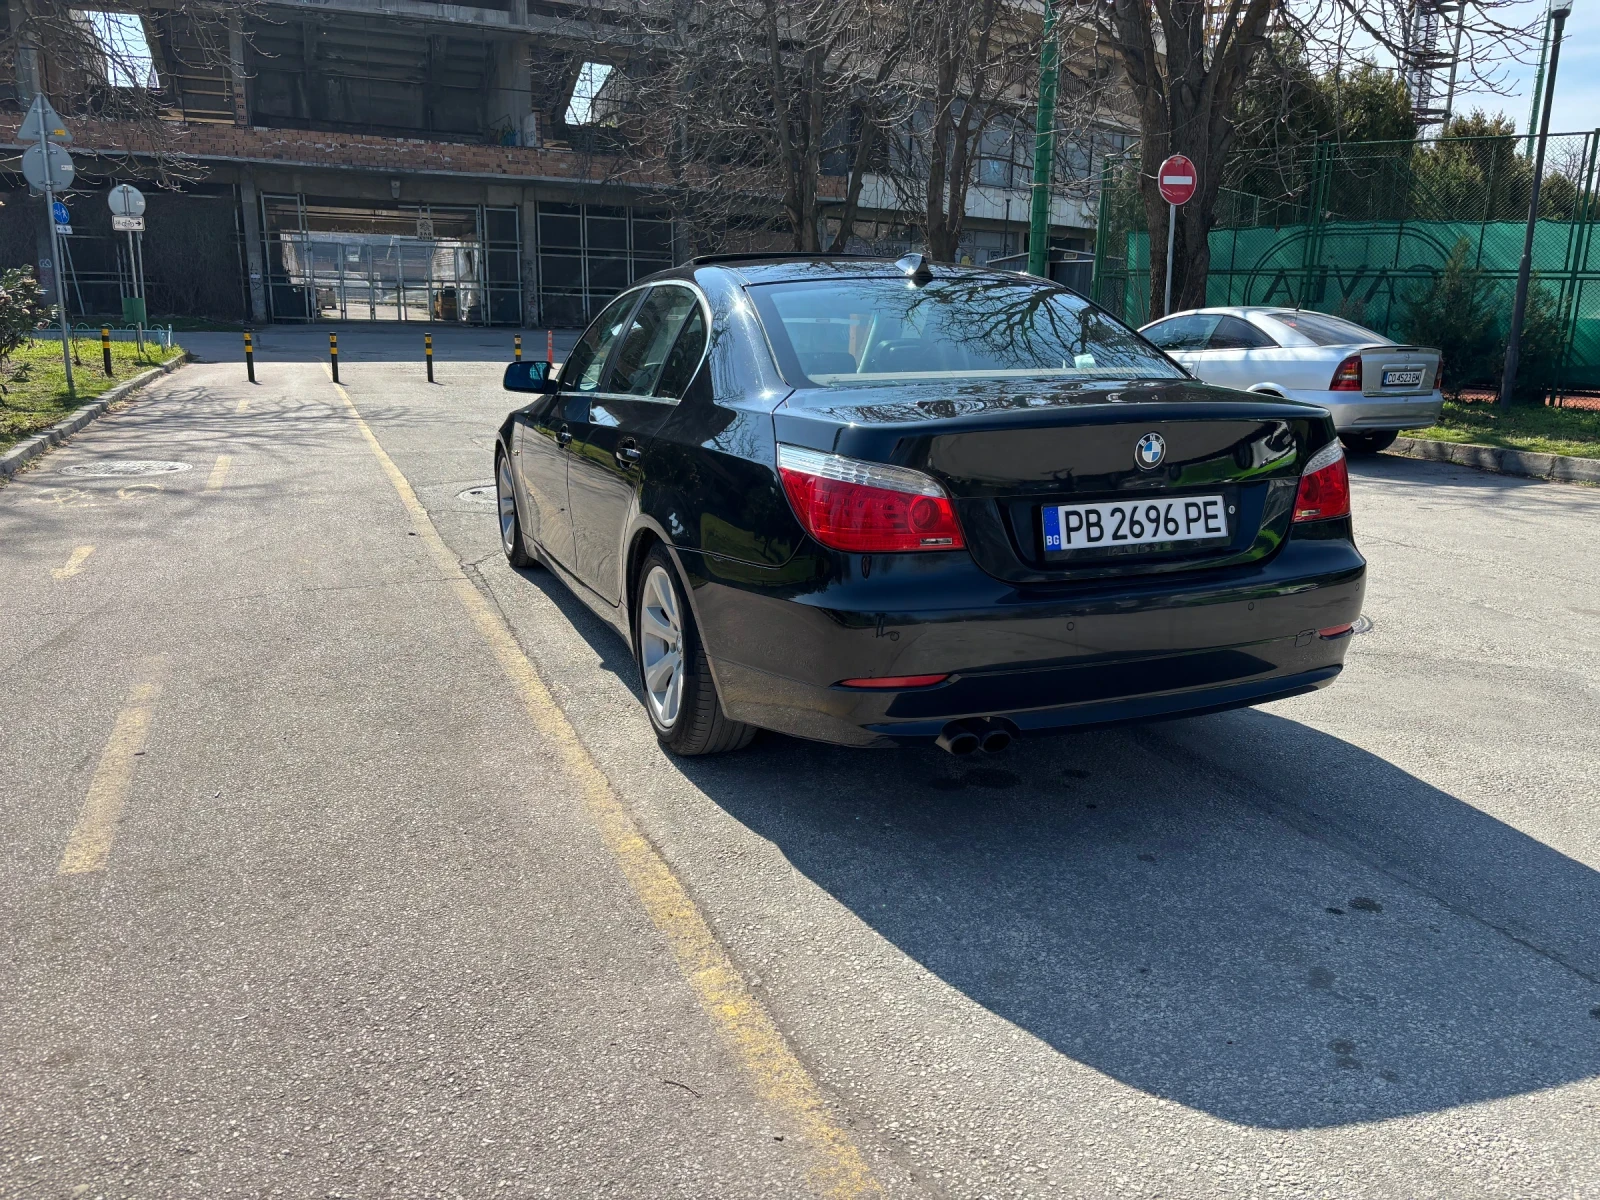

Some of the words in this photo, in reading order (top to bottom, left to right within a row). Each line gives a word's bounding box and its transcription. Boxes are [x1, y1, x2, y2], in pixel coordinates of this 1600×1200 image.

[1139, 433, 1164, 447] BMW
[1064, 509, 1104, 544] PB
[1110, 503, 1180, 541] 2696
[1184, 500, 1221, 535] PE
[1046, 535, 1060, 545] BG
